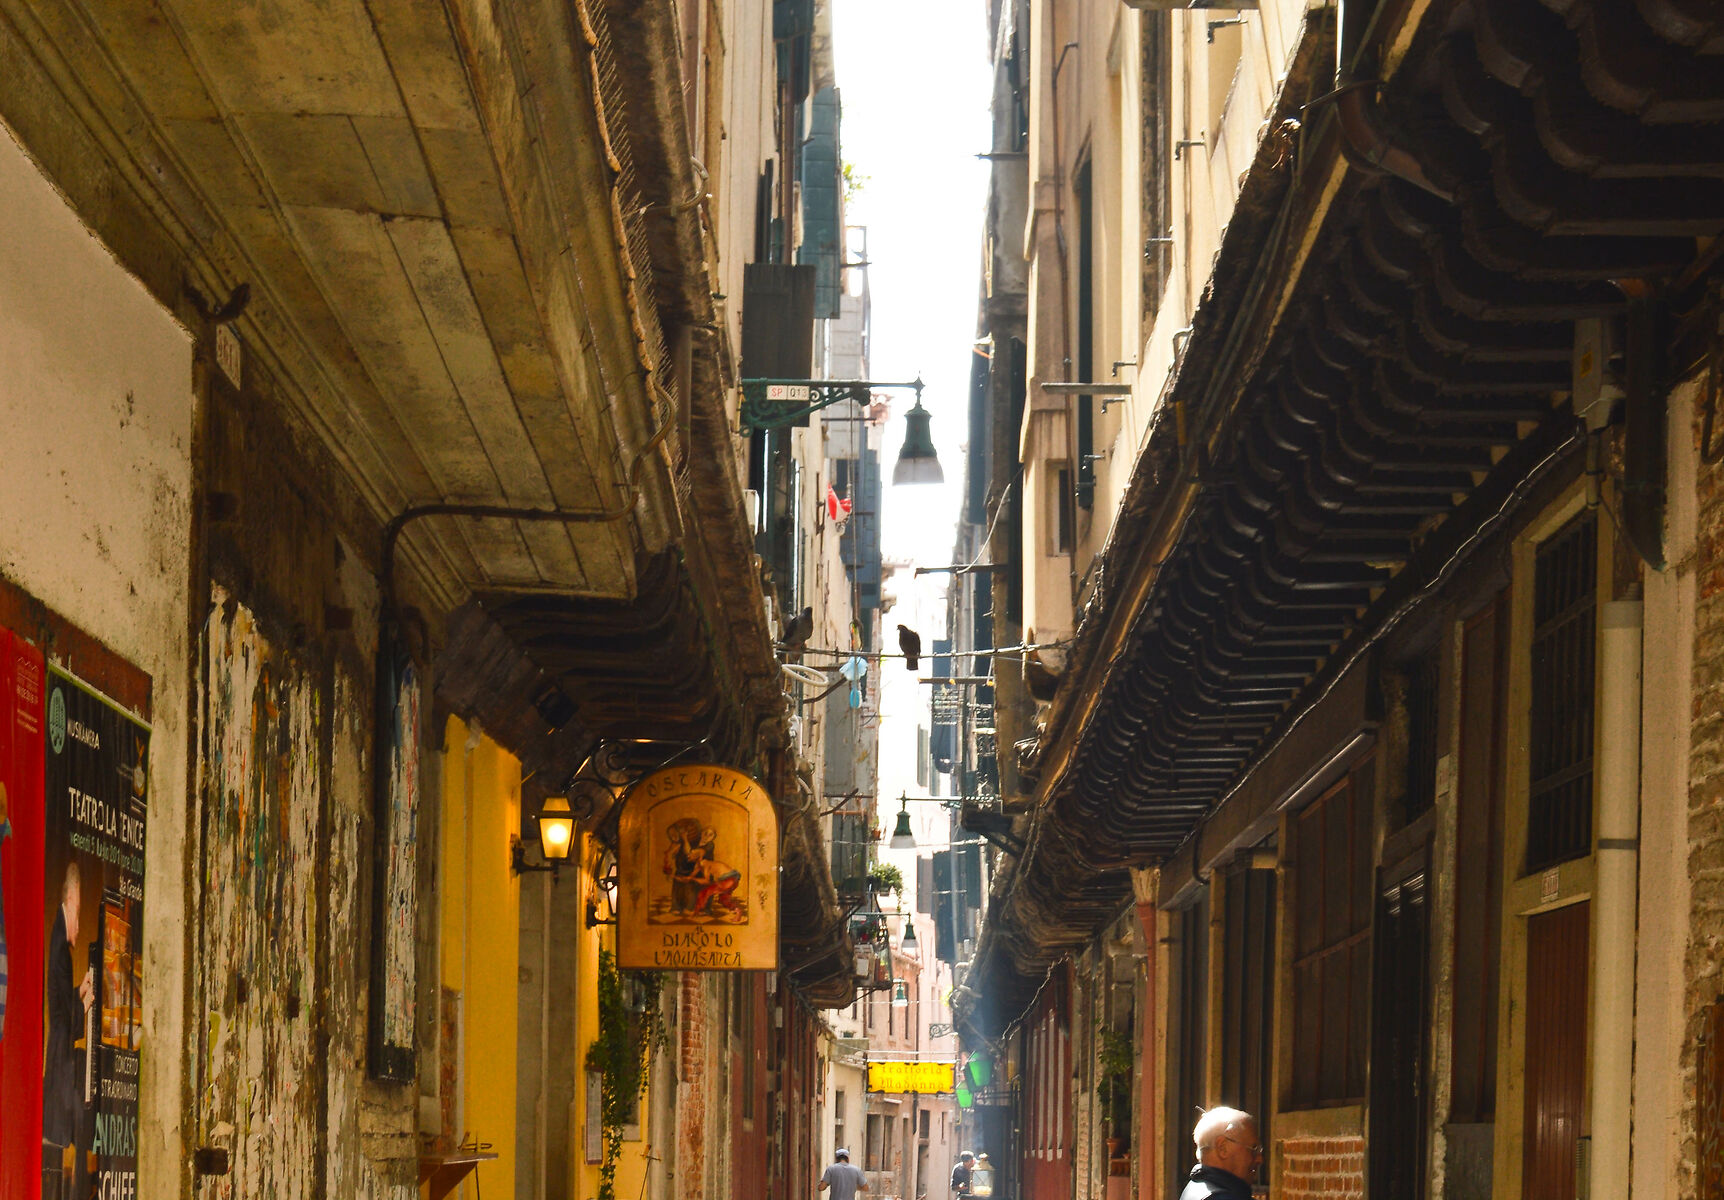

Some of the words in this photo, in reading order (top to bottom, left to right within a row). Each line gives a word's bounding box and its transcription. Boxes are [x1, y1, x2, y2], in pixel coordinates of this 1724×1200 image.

[771, 387, 783, 397] SP
[646, 771, 754, 801] OSTARIA
[68, 786, 104, 832] TEATRO
[105, 804, 117, 838] LA
[662, 932, 733, 948] DIAVOLO
[115, 1054, 139, 1076] CONCERTO
[92, 1106, 136, 1158] ANDRÁS
